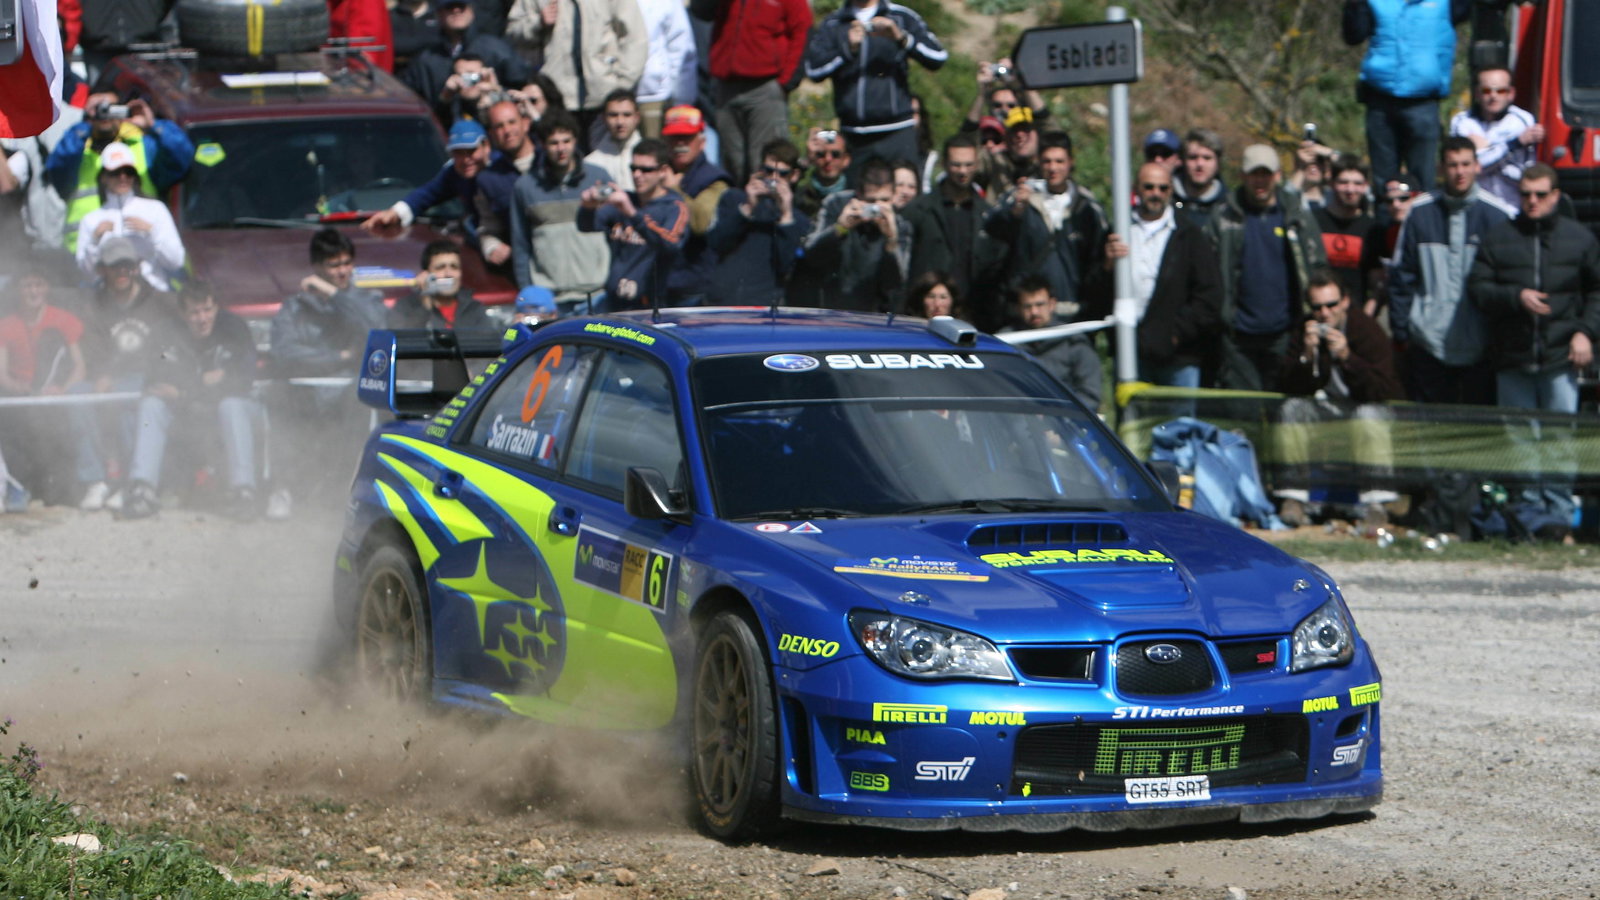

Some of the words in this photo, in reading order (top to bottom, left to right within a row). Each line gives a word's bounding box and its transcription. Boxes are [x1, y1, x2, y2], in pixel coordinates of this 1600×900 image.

[1047, 41, 1129, 70] Esblada
[584, 323, 656, 346] subaru-global.com
[825, 354, 985, 369] SUBARU
[360, 377, 387, 392] SUBARU
[521, 345, 563, 423] 6
[487, 414, 538, 456] Sarrazin
[592, 555, 620, 575] movistar
[624, 549, 646, 569] RACC
[901, 559, 957, 567] movistar
[980, 549, 1166, 564] SUBARU
[993, 558, 1058, 568] WORLD
[1123, 556, 1175, 564] TEAM
[649, 555, 664, 606] 6
[778, 633, 840, 658] DENSO
[1349, 682, 1380, 707] PIRELLI
[872, 702, 948, 724] PIRELLI
[1112, 706, 1149, 719] STI
[1150, 705, 1245, 718] Performance
[1302, 696, 1339, 713] MOTUL
[969, 711, 1027, 726] MOTUL
[846, 728, 887, 745] PIAA
[1094, 724, 1245, 775] PIRELLI
[850, 772, 888, 790] BBS
[1130, 783, 1169, 799] GT55
[1176, 780, 1206, 797] SRT
